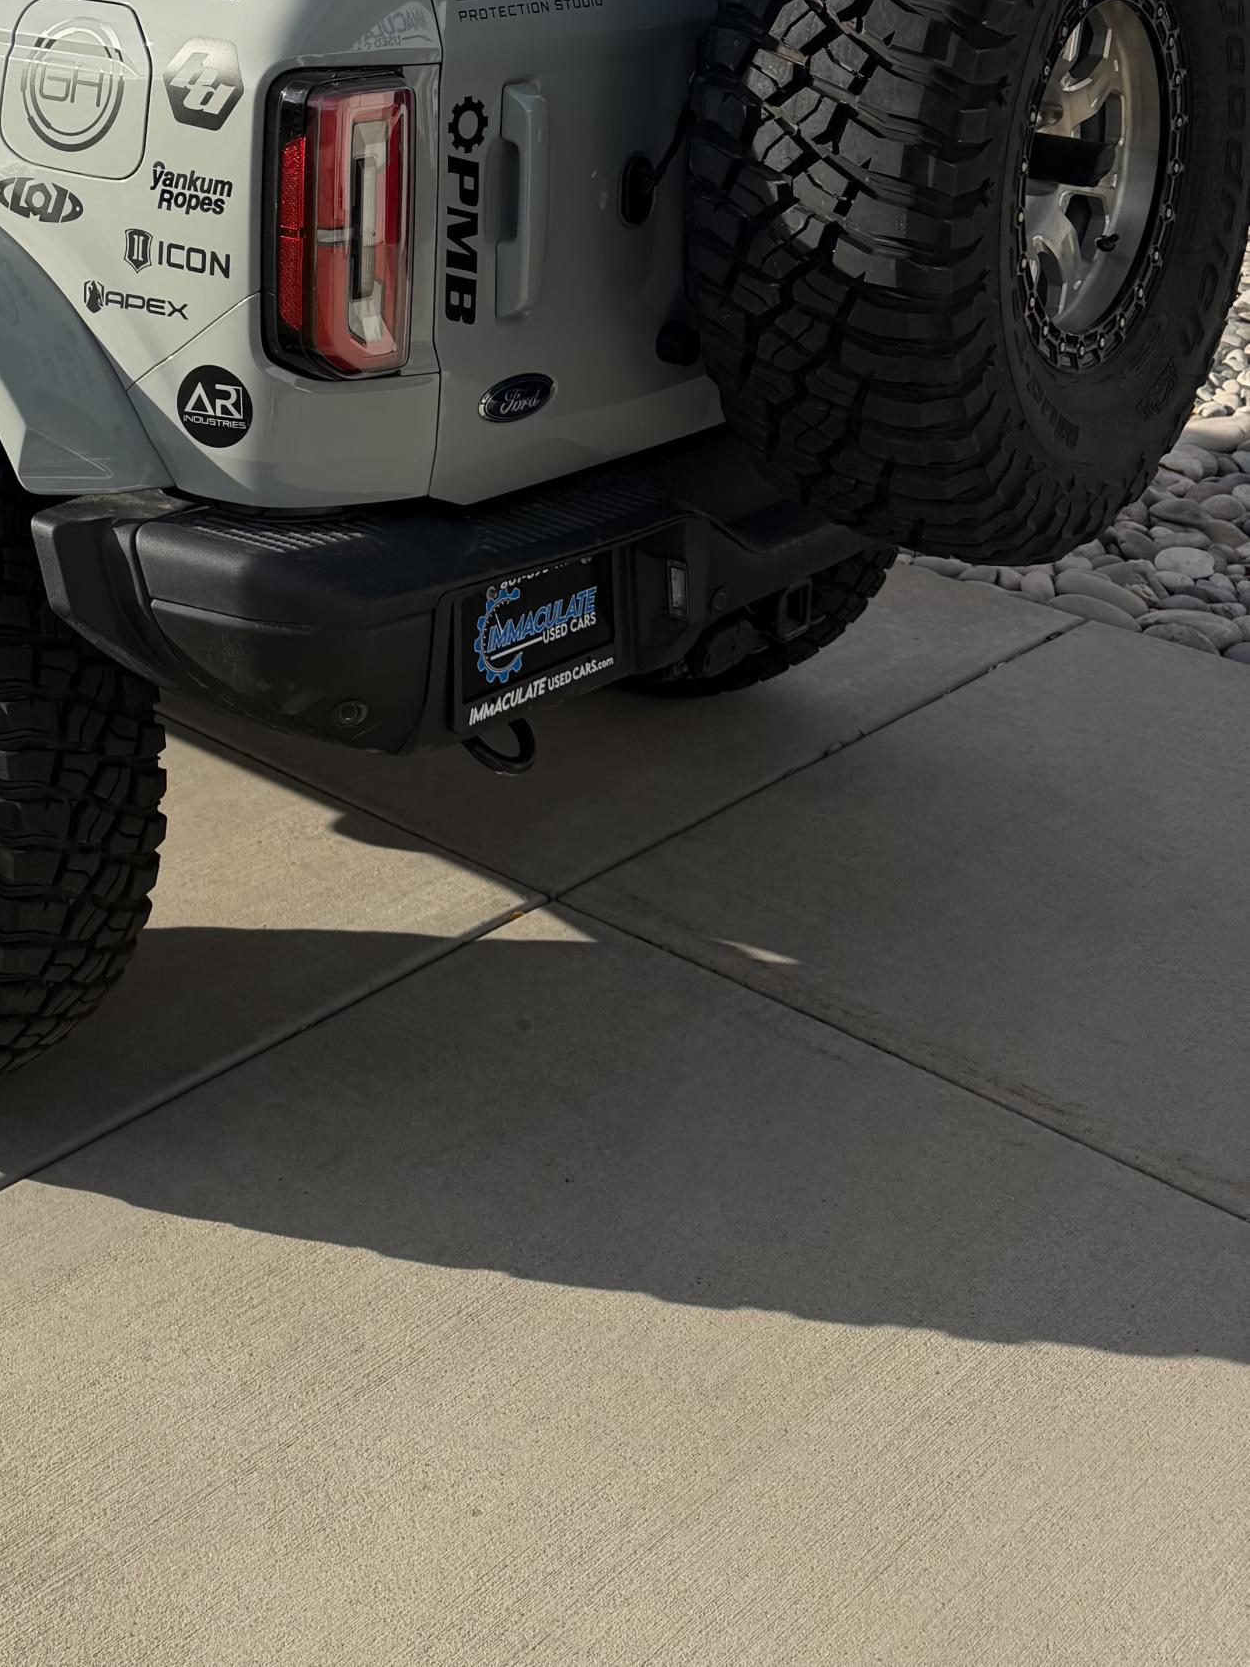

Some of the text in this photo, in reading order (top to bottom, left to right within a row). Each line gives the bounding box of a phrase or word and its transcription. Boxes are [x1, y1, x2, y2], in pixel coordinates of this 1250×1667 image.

[458, 0, 550, 23] PROTECTION
[157, 188, 226, 215] Ropes
[158, 240, 231, 279] ICON
[105, 290, 189, 321] APEX
[500, 386, 542, 415] Ford
[182, 414, 247, 430] INDUSTRIES
[486, 585, 598, 653] IMMACULATE
[542, 612, 597, 644] USED CARS
[468, 676, 547, 726] IMMACULATE
[547, 671, 572, 691] USED
